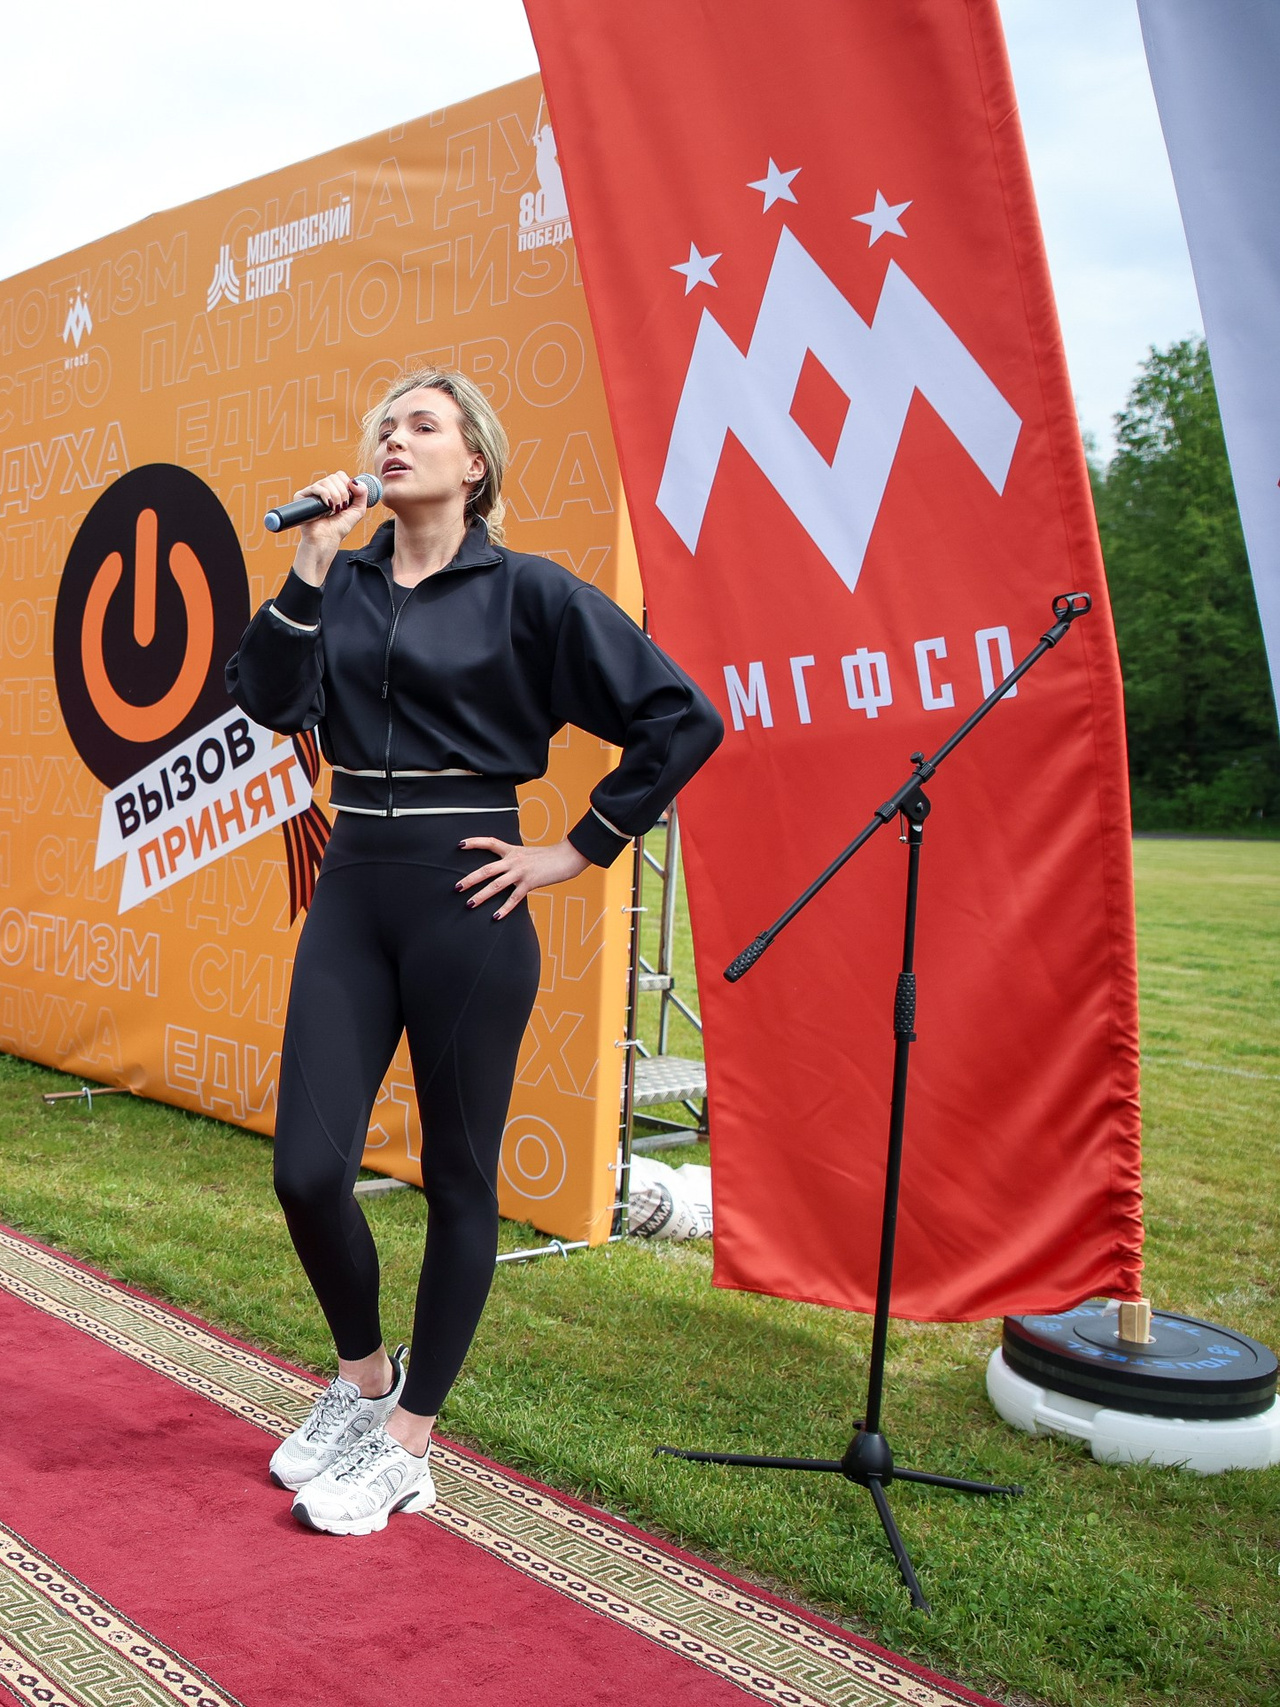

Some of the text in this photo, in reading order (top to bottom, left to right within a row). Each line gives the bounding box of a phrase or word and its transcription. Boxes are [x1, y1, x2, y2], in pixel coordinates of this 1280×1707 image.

[245, 257, 293, 302] СПОРТ
[246, 196, 351, 268] МОСКОВСКИЙ
[517, 219, 573, 253] ПОБЕДА
[140, 224, 584, 393] ПАТРИОТИЗ
[722, 625, 1019, 732] МГФСО
[114, 717, 256, 840] ВЫЗОВ
[137, 753, 298, 889] ПРИНЯТ
